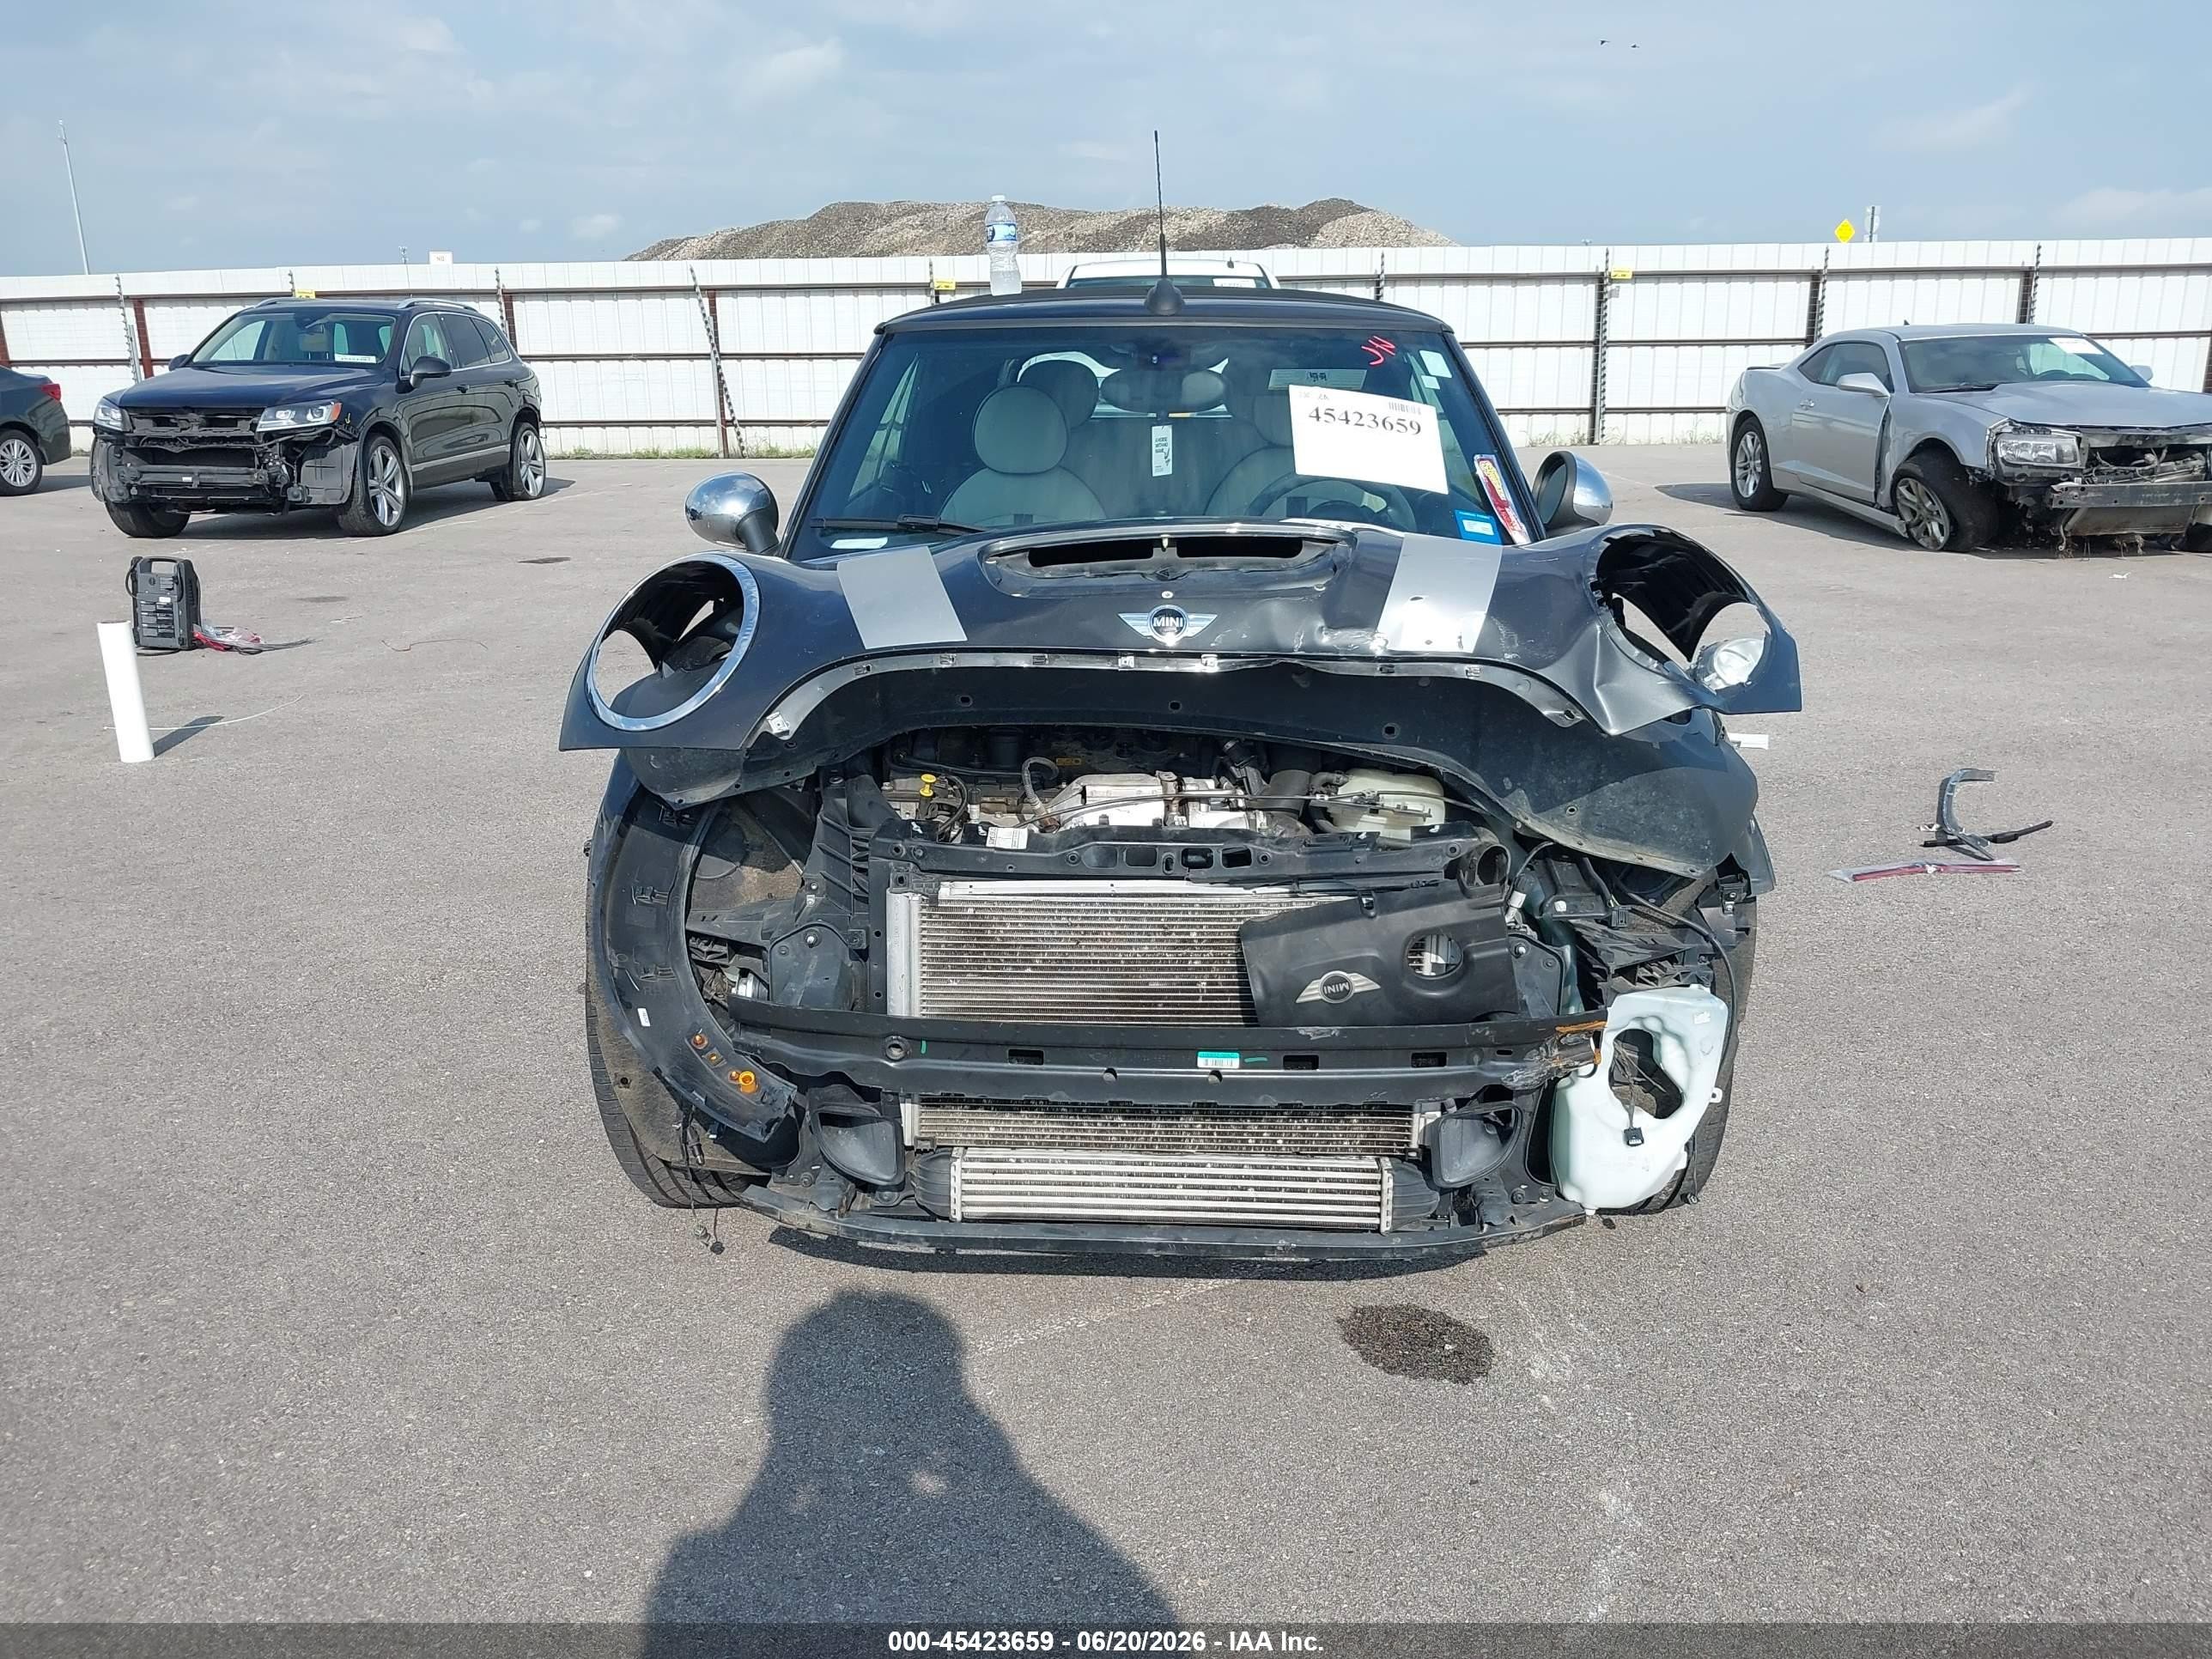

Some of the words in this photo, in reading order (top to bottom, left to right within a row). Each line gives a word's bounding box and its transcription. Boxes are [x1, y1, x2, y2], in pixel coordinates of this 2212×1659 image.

[1308, 406, 1422, 435] 45423659
[1153, 617, 1183, 627] MINI
[1323, 981, 1350, 994] MINI
